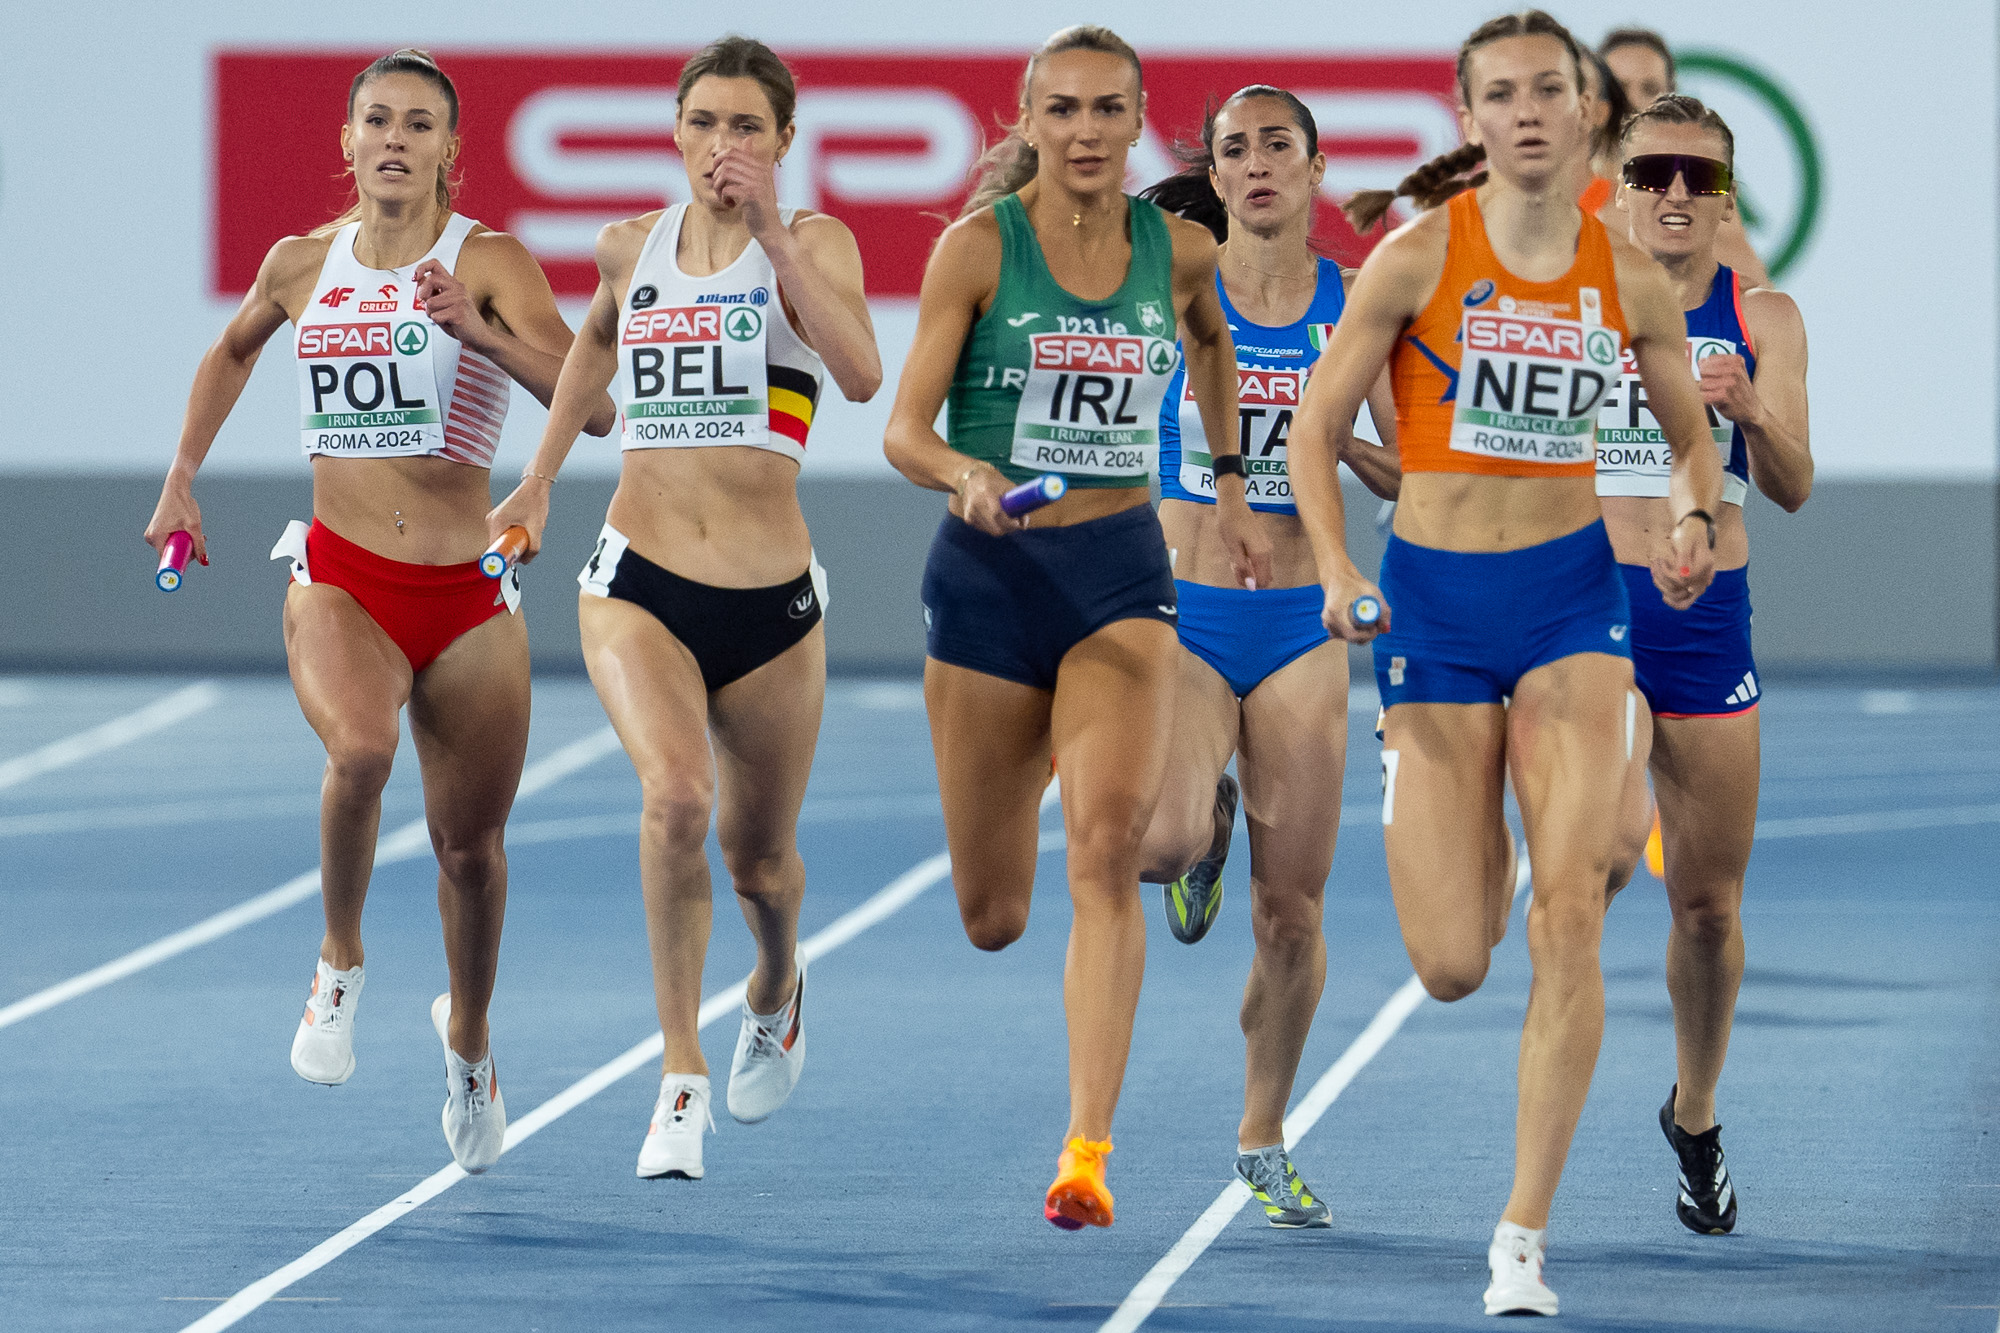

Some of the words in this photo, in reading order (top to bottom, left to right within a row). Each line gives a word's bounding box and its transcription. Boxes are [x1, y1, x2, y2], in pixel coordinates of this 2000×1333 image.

[319, 287, 355, 307] 4F
[696, 293, 746, 303] Allianz
[361, 303, 395, 312] ORLEN
[626, 311, 717, 340] SPAR
[301, 327, 390, 353] SPAR
[1470, 321, 1581, 356] SPAR
[1038, 340, 1141, 368] SPAR
[1235, 345, 1303, 355] FRECCIAROSSA
[632, 345, 748, 398] BEL
[310, 362, 425, 413] POL
[1473, 358, 1605, 419] NED
[643, 405, 647, 415] I
[650, 404, 677, 415] RUN
[1050, 374, 1138, 425] IRL
[333, 414, 357, 426] RUN
[1497, 416, 1529, 430] RUN
[317, 433, 371, 449] ROMA
[376, 431, 422, 447] 2024
[636, 424, 689, 440] ROMA
[695, 421, 744, 438] 2024
[1058, 430, 1090, 442] RUN
[1239, 409, 1293, 456] TA
[1604, 431, 1608, 441] I
[1612, 431, 1643, 441] RUN
[1475, 432, 1538, 454] ROMA
[1037, 447, 1098, 466] ROMA
[1104, 451, 1143, 468] 2024
[1252, 461, 1288, 473] CLEA
